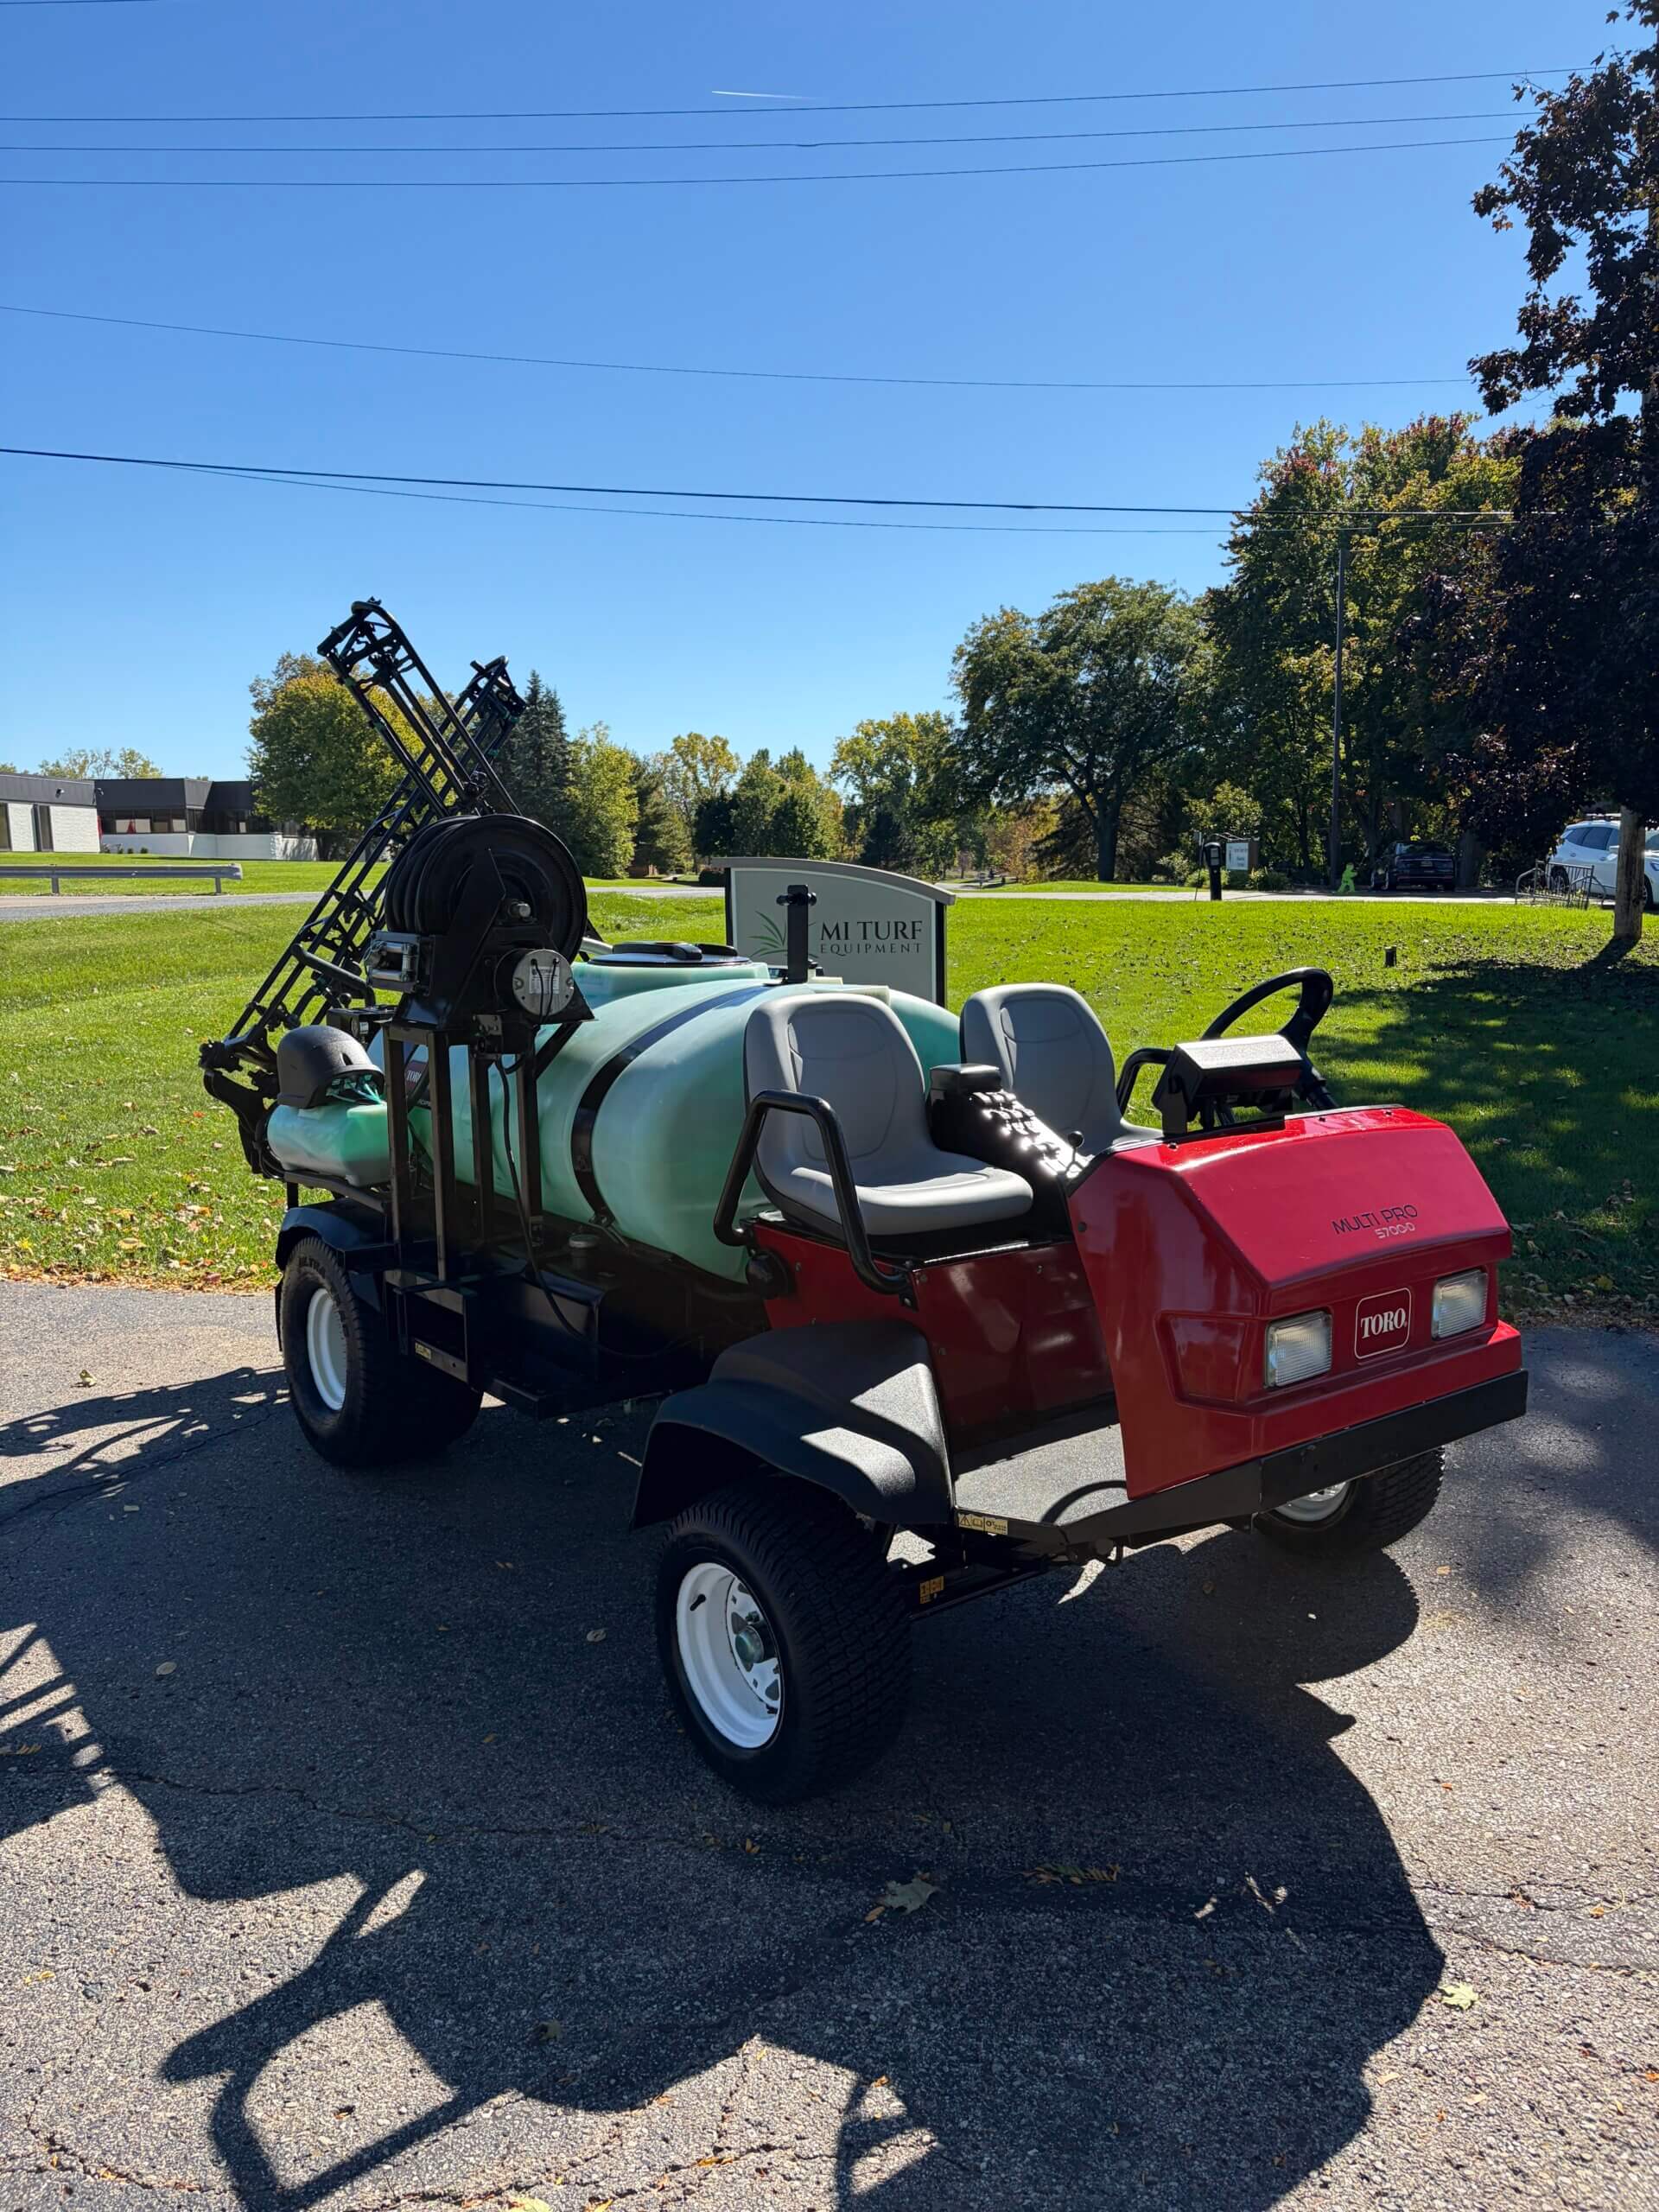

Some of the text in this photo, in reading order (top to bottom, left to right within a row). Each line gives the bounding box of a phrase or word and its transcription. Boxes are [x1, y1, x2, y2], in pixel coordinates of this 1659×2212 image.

[821, 920, 923, 941] MI TURF
[820, 943, 922, 957] EQUIPMENT
[406, 1070, 422, 1084] TOR
[1332, 1205, 1418, 1235] MULTI PRO
[1360, 1307, 1407, 1339] TORO
